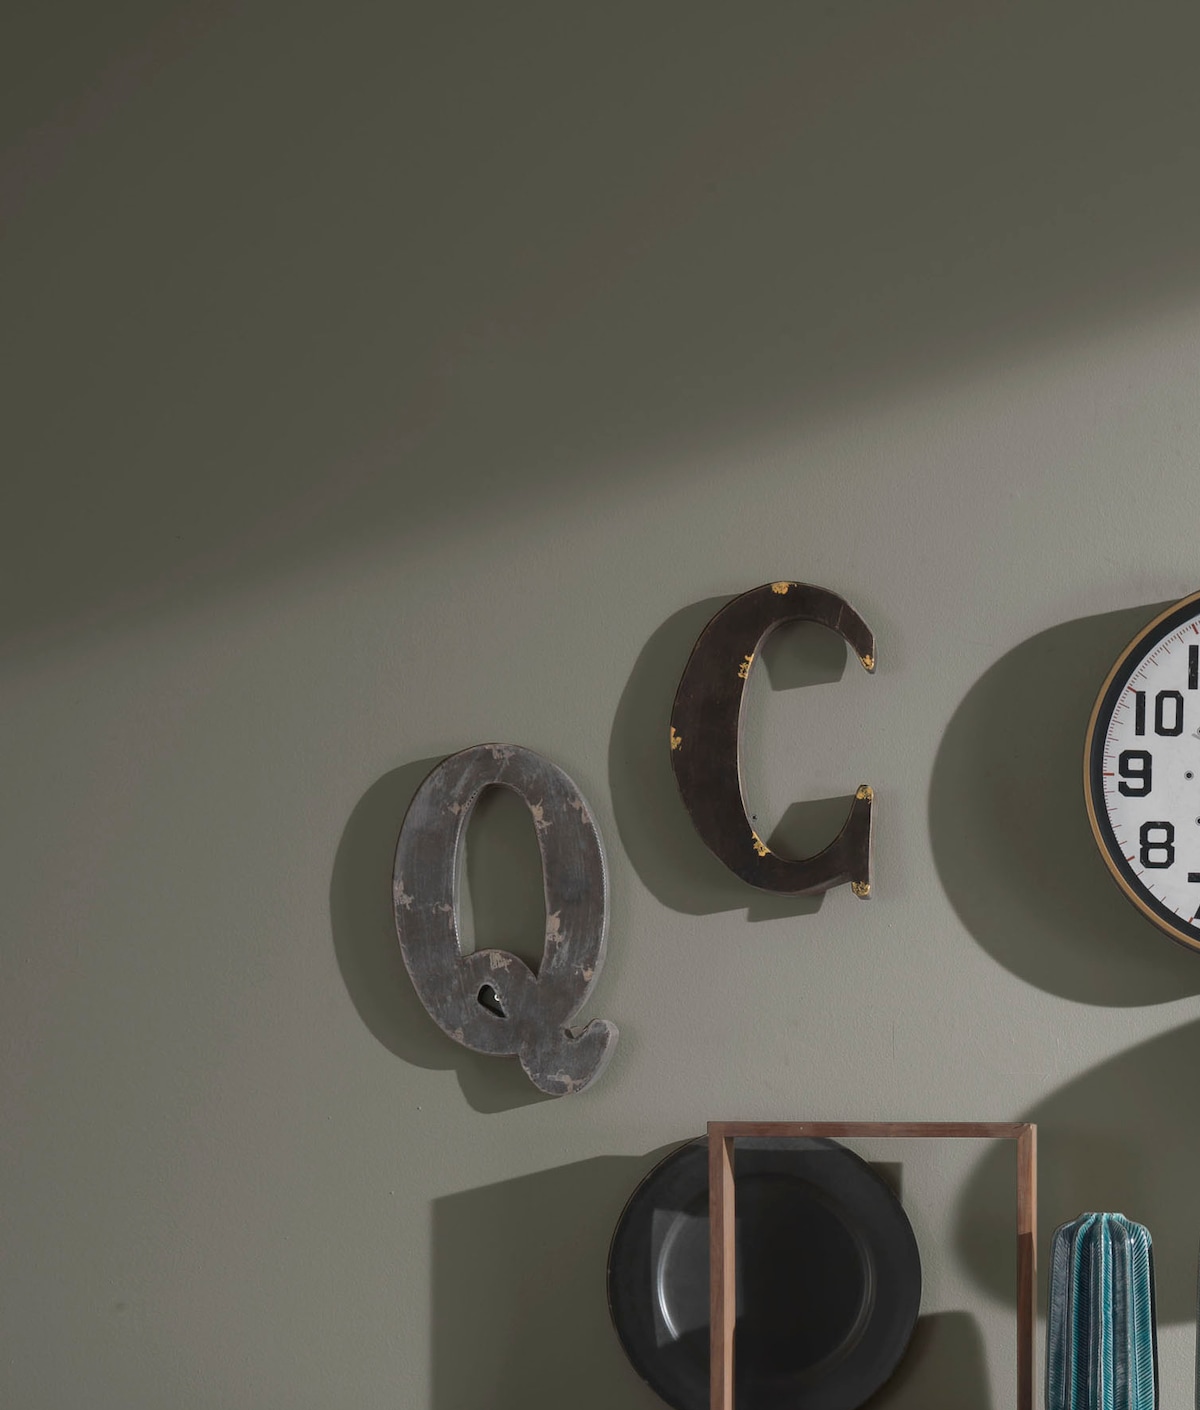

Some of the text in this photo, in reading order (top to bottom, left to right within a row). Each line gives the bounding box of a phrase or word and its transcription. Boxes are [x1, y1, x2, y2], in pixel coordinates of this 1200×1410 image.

[1134, 690, 1184, 737] 10
[1118, 749, 1152, 797] 9
[1139, 821, 1175, 869] 8
[392, 743, 619, 1097] Q
